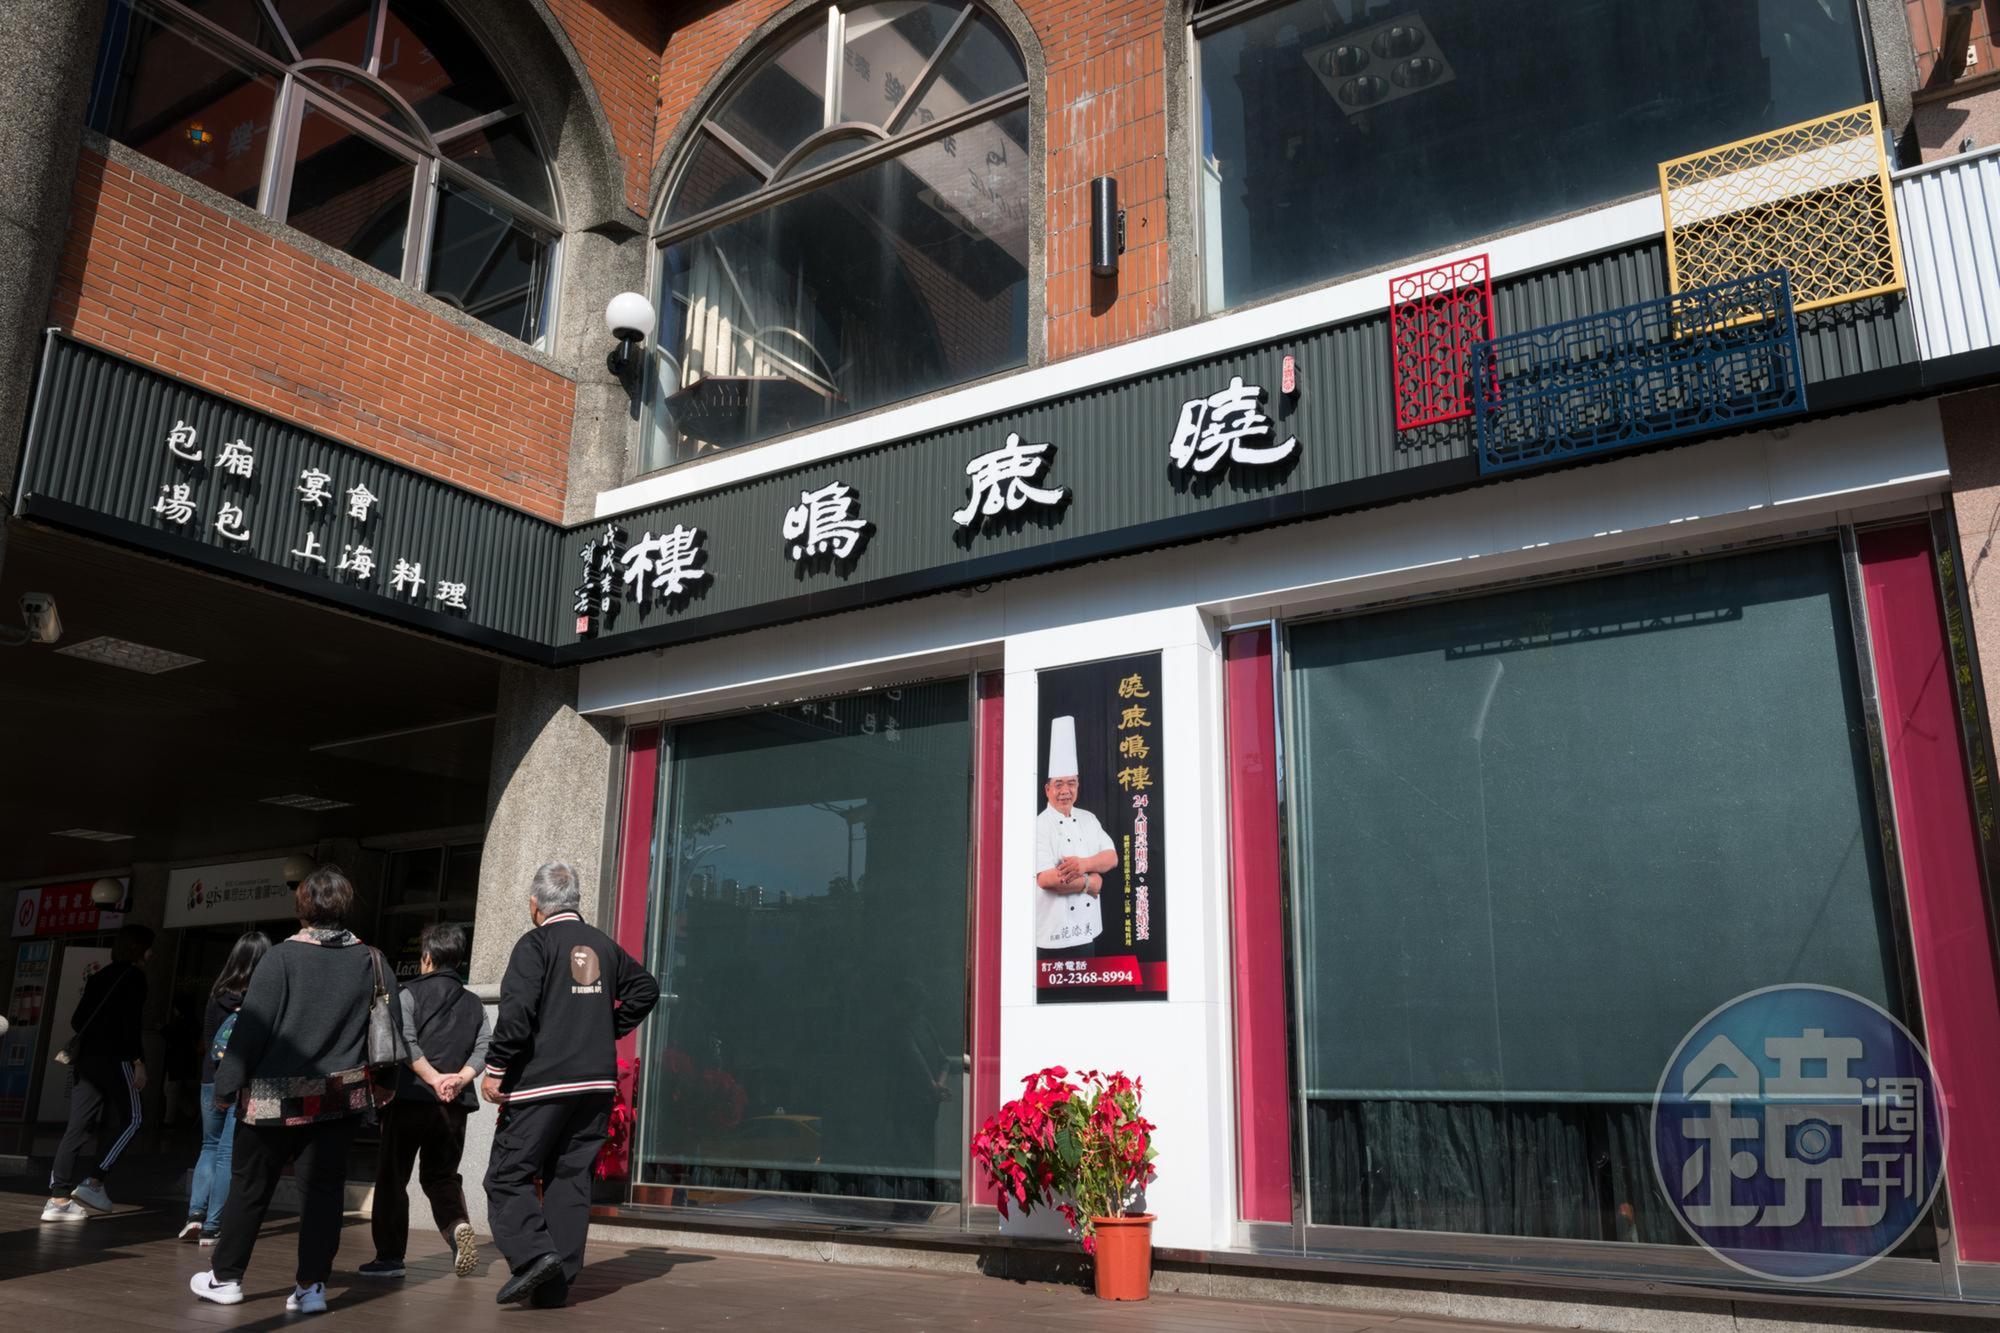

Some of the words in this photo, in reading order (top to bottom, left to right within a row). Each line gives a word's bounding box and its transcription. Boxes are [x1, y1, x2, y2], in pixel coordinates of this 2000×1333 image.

[166, 420, 254, 479] 包廂
[295, 468, 379, 522] 宴會
[150, 483, 251, 542] 湯包
[291, 531, 468, 611] 上海料理
[1117, 672, 1154, 792] 曉鹿鳴樓
[1041, 961, 1088, 973] 訂席電話
[1048, 970, 1134, 985] 02-2368-8994
